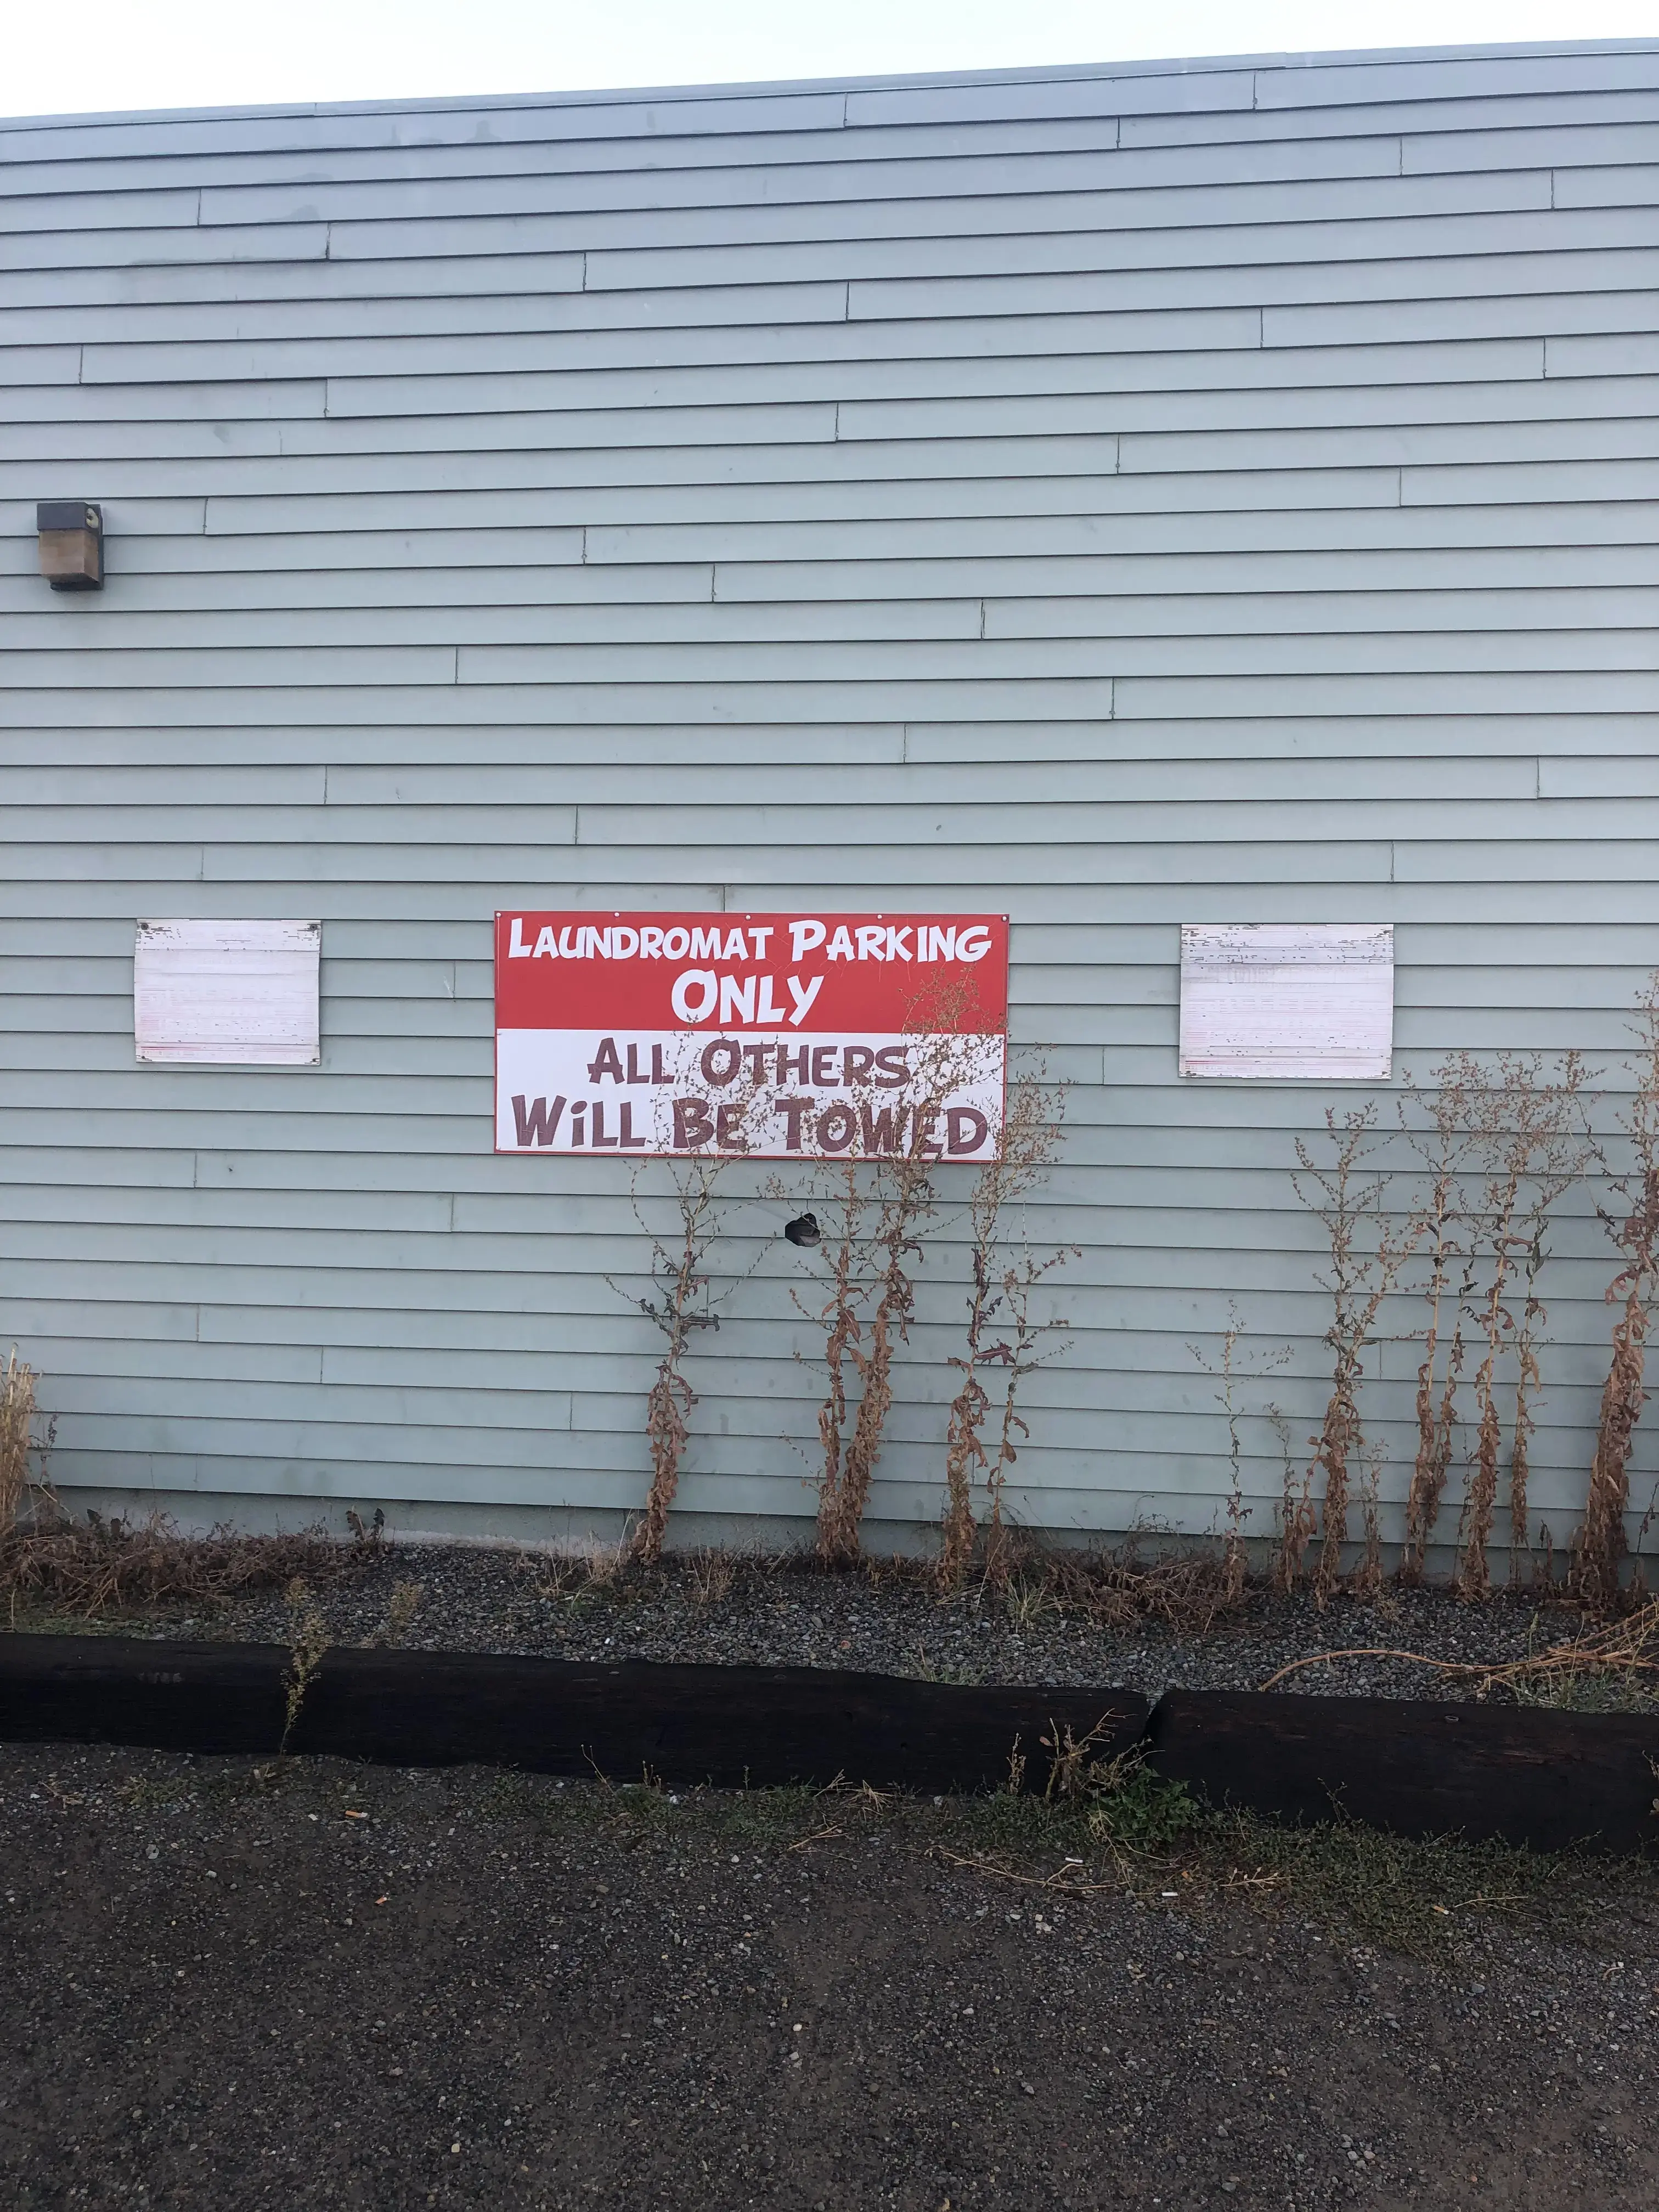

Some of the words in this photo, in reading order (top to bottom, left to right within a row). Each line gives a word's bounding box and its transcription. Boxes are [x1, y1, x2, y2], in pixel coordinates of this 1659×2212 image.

[508, 918, 774, 961] LAUNDROMAT
[788, 919, 992, 962] PARKING
[671, 969, 825, 1026] ONLY
[586, 1037, 675, 1085] ALL
[701, 1039, 911, 1088] OTHERS
[673, 1097, 749, 1149] BE
[775, 1098, 988, 1155] TOWED
